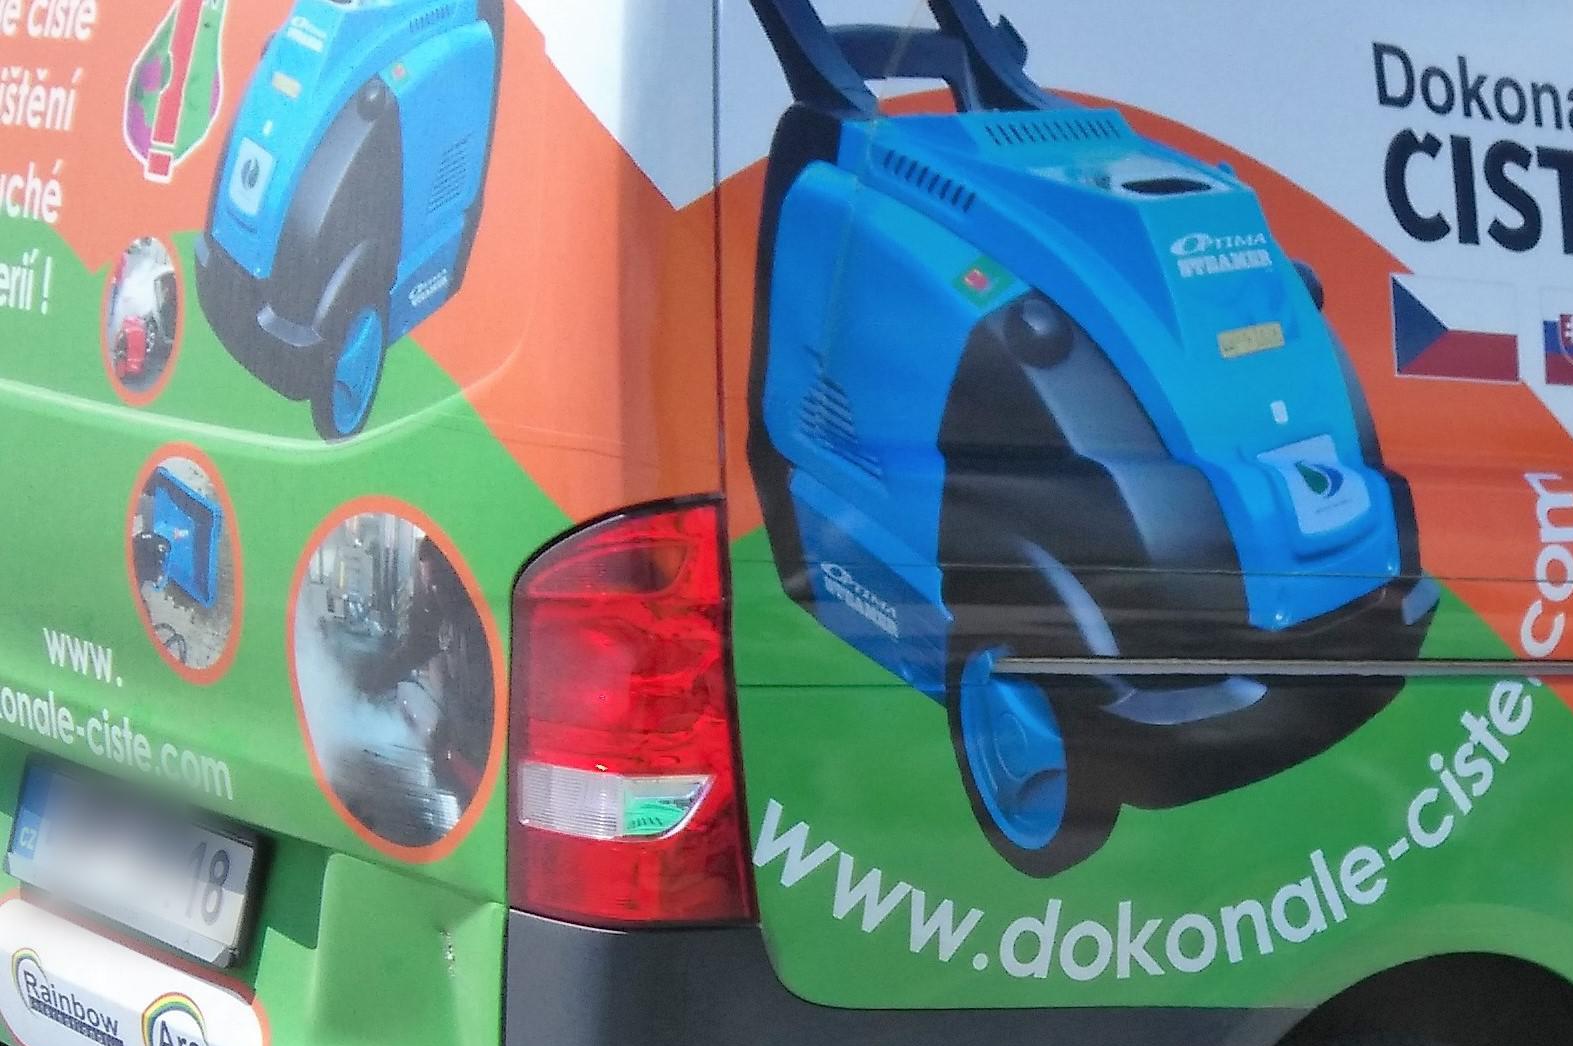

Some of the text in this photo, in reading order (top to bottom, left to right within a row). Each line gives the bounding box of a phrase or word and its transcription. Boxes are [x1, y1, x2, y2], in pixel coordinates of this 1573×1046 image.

[43, 627, 123, 687] www.
[0, 686, 234, 801] onale-ciste.com
[20, 826, 38, 851] CZ
[24, 970, 119, 1036] Rainbow
